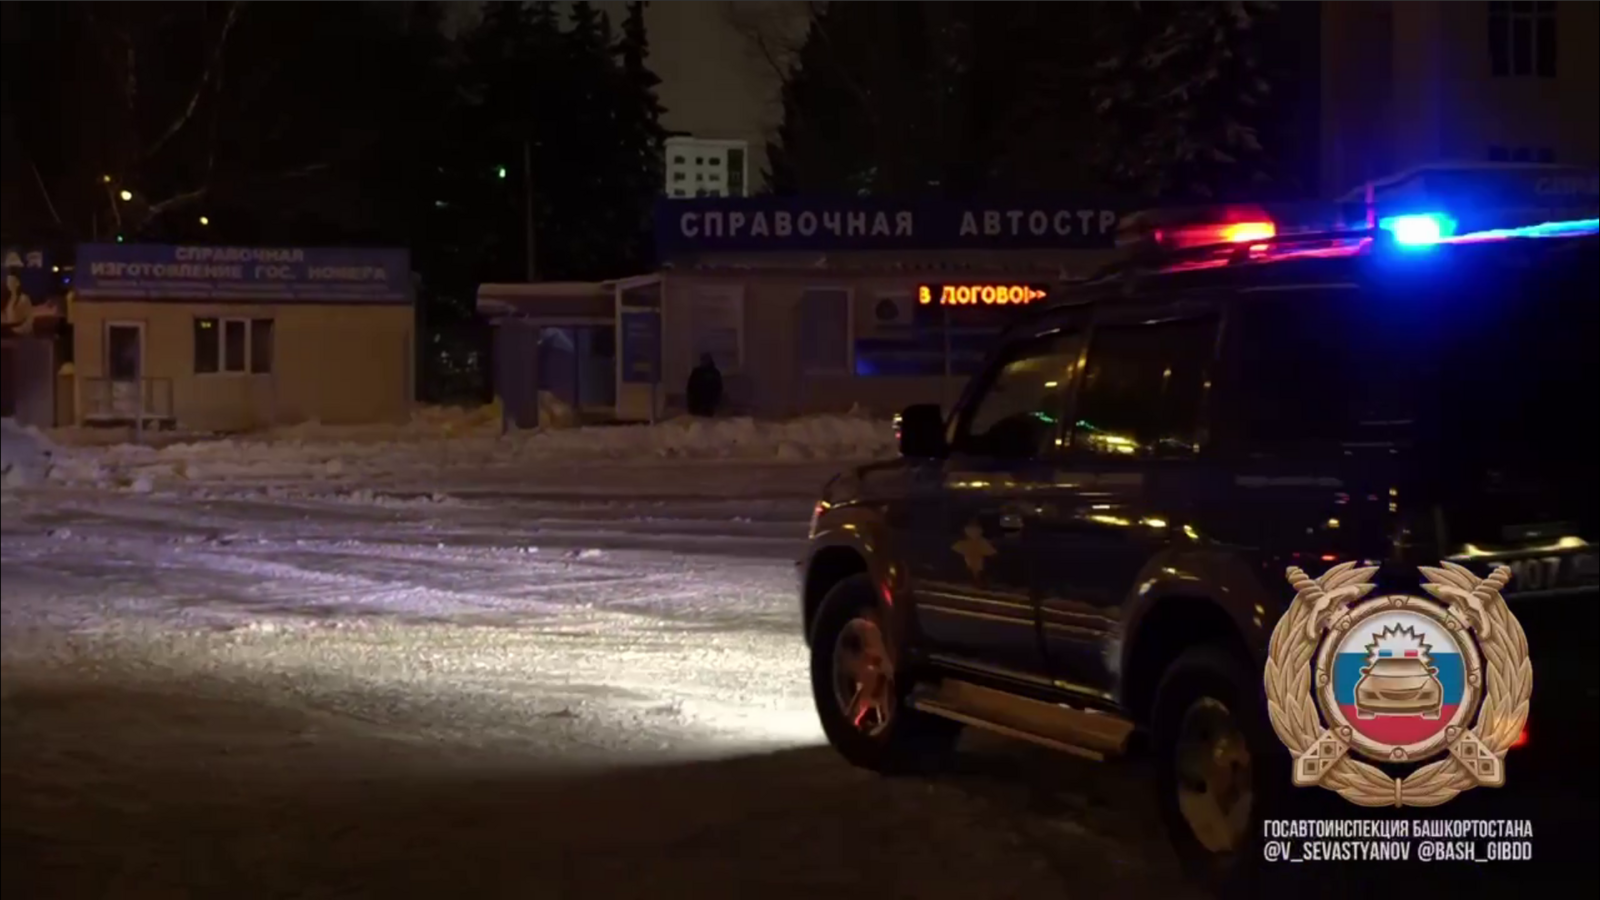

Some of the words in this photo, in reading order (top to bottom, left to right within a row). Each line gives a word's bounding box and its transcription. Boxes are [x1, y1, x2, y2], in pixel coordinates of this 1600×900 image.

[680, 210, 914, 238] СПРАВОЧНАЯ
[959, 209, 1116, 237] АВТОСТР
[174, 246, 305, 262] СПРАВОЧНАЯ
[91, 261, 244, 279] ИЗГОТОВЛЕНИЕ
[254, 265, 297, 280] ГОС.
